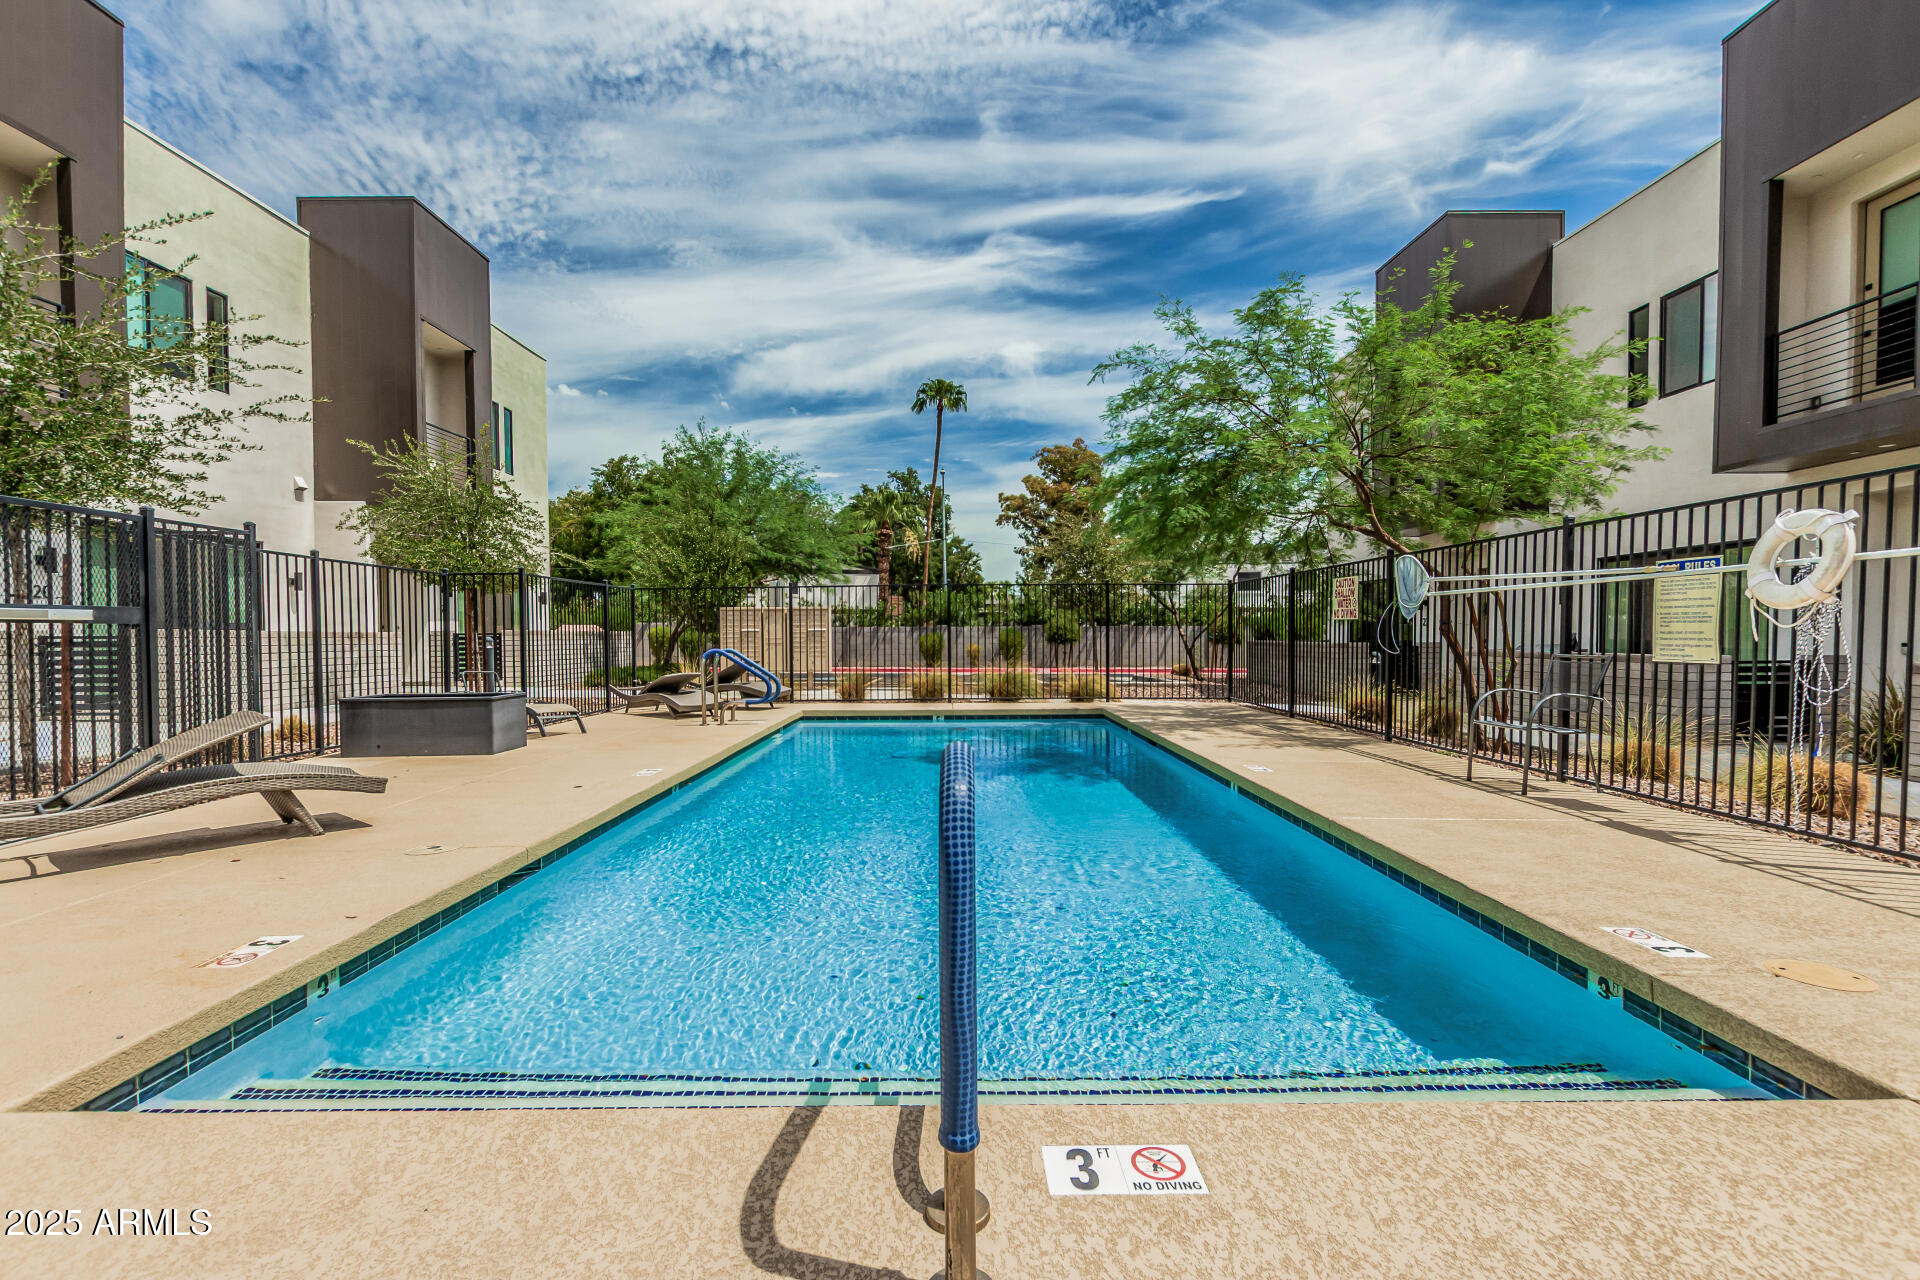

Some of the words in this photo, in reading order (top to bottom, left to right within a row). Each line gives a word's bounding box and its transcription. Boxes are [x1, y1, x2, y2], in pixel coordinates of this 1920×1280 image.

[1335, 577, 1355, 589] CAUTION
[1334, 588, 1355, 598] SHALLOW
[1337, 598, 1352, 608] WATER
[1333, 609, 1341, 618] NO
[1341, 608, 1357, 618] DIVING
[317, 974, 329, 998] 3
[1597, 976, 1611, 1000] 3
[1066, 1148, 1100, 1191] 3
[1097, 1147, 1110, 1159] FT
[1132, 1182, 1152, 1191] NO
[1157, 1181, 1203, 1191] DIVING
